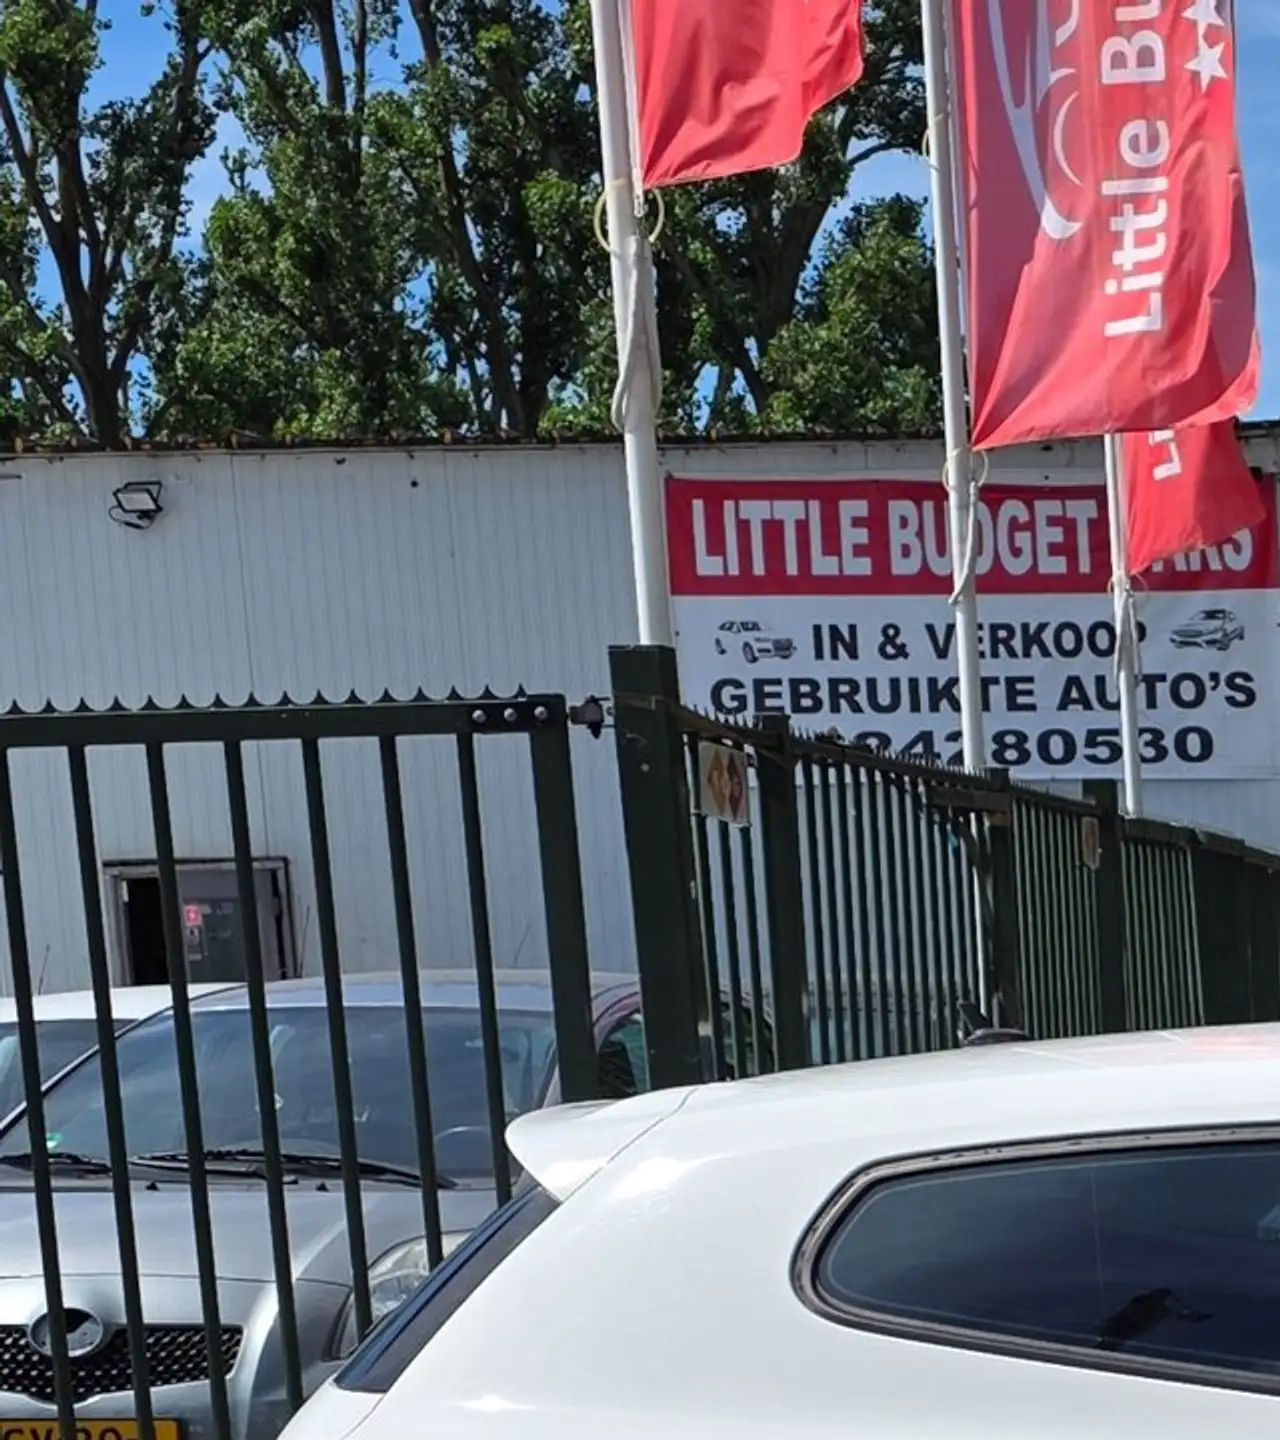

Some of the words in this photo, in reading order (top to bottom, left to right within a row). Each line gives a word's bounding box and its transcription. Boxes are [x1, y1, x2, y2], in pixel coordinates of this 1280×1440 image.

[1101, 118, 1170, 337] Little
[692, 498, 872, 576] LITTLE
[812, 623, 859, 661] IN
[877, 622, 909, 661] &
[710, 675, 1037, 715] GEBRUIKTE
